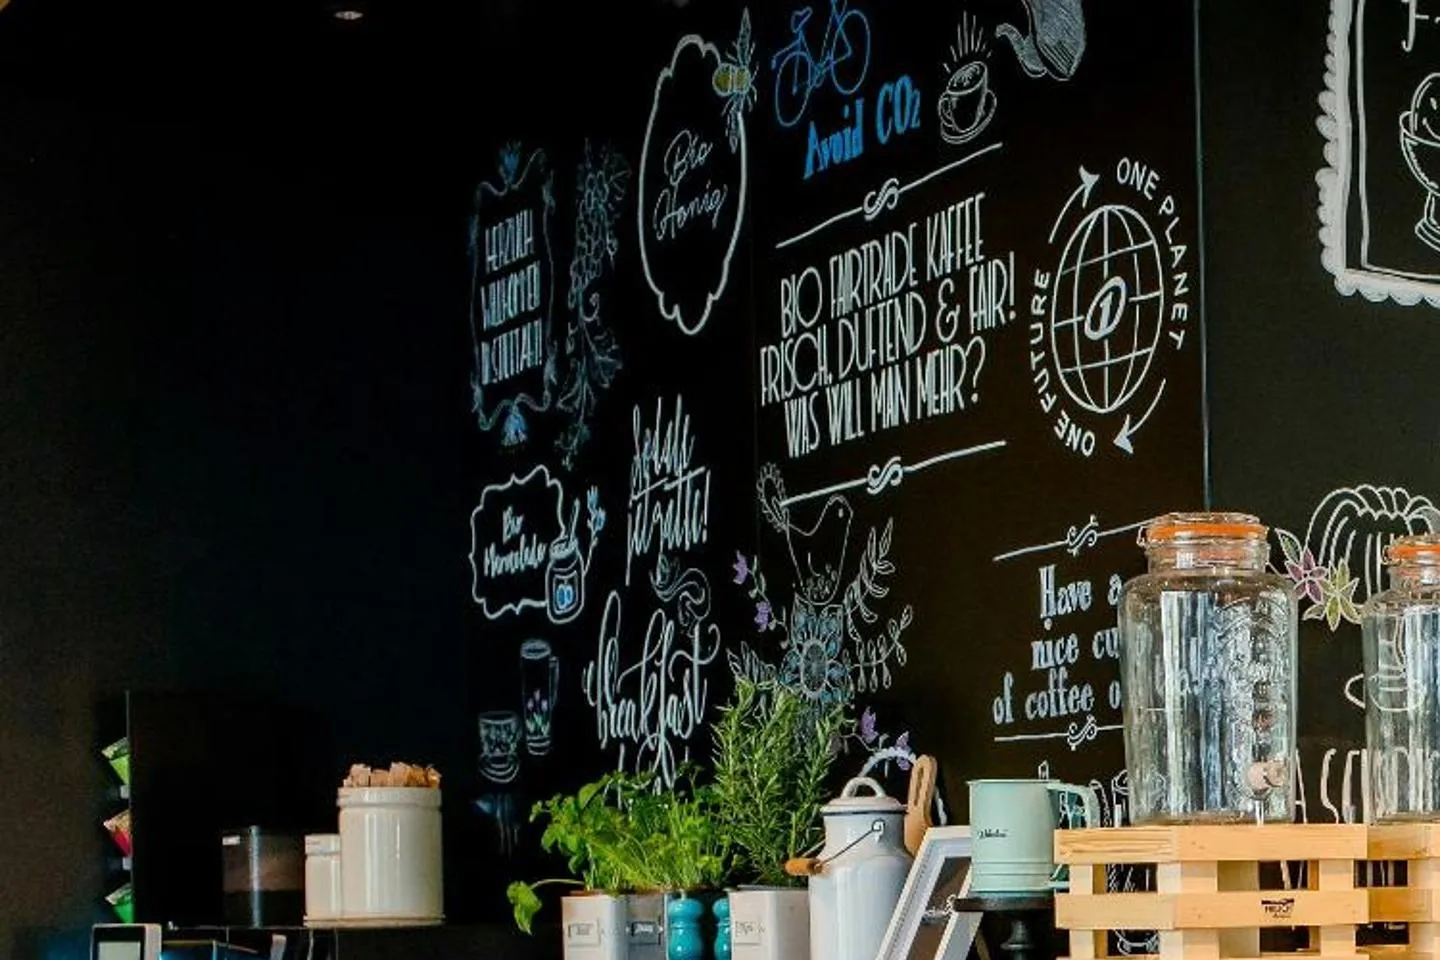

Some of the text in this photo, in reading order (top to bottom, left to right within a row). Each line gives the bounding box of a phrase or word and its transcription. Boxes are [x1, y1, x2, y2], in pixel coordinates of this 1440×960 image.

[664, 130, 712, 185] Bio
[804, 98, 864, 179] Avoid
[653, 181, 728, 240] Honig
[780, 192, 986, 340] BIO FAIRTRADE KAFFEE
[1116, 157, 1189, 350] ONE PLANET
[760, 251, 1016, 407] FRISCH, DUFTEND & FAIR!
[1030, 269, 1096, 457] ONE FUTURE
[785, 335, 986, 458] WAS WILL MAN MEHR?
[1038, 566, 1122, 620] Have a
[1031, 617, 1079, 670] nice
[992, 671, 1014, 725] of
[1025, 667, 1095, 718] coffee
